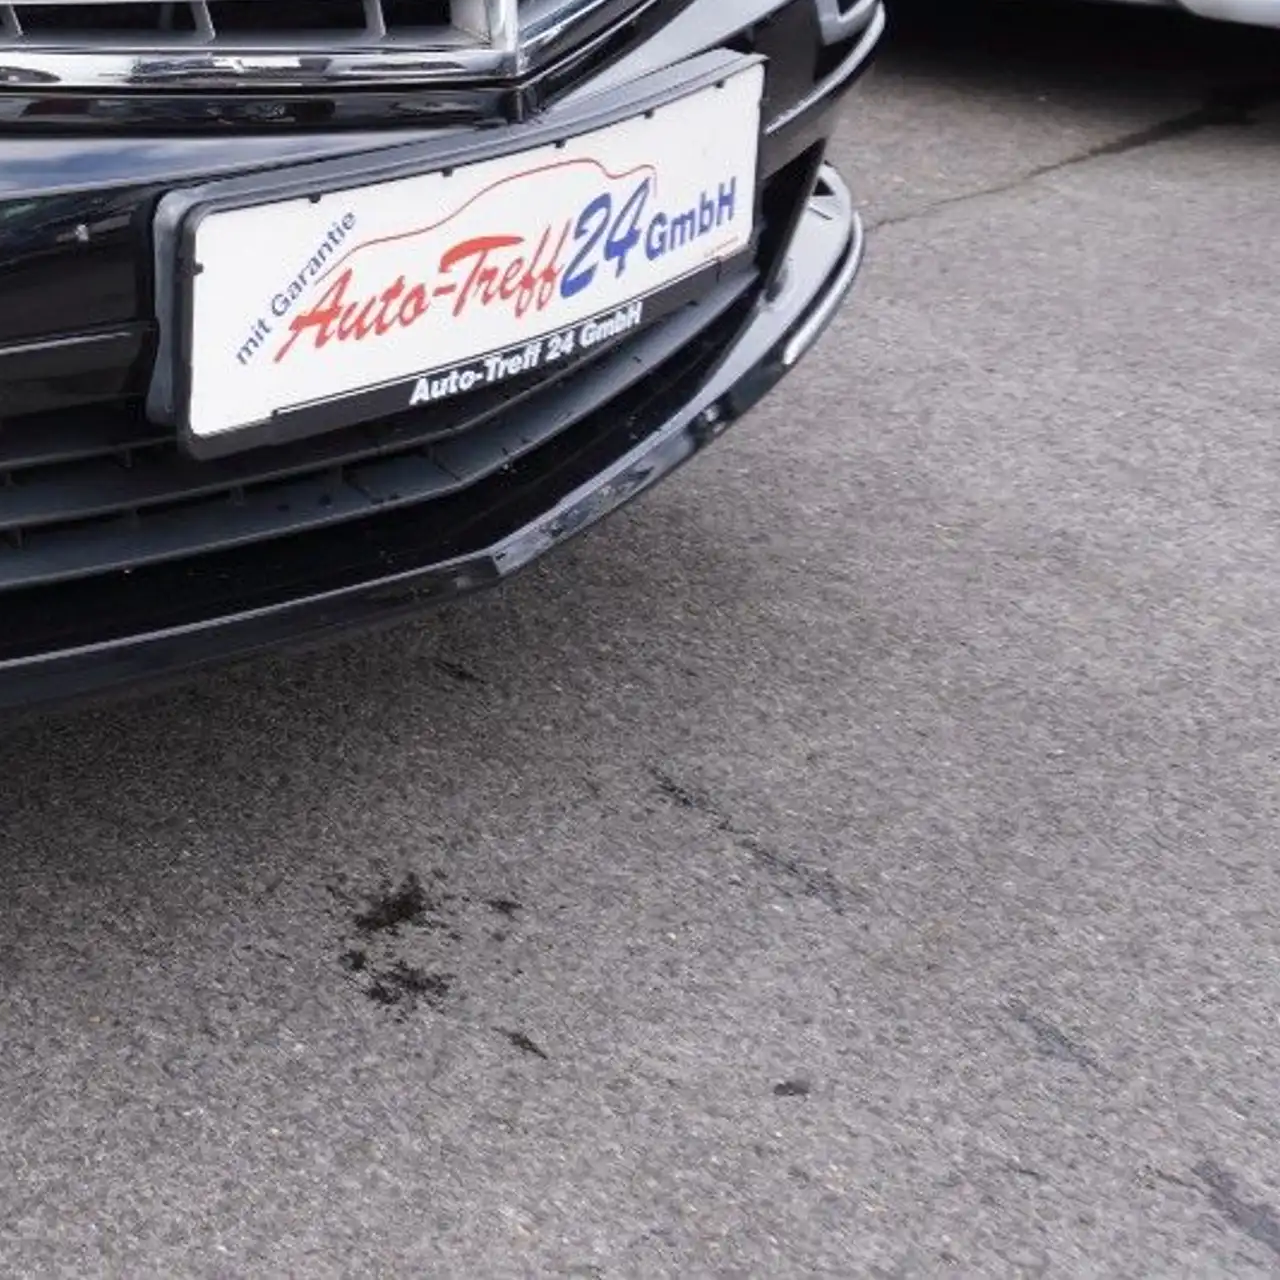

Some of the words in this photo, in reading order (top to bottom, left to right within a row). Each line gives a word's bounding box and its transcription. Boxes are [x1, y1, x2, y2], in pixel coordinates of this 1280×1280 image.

[645, 176, 737, 260] GmbH
[236, 318, 272, 365] mit
[271, 212, 357, 317] Garantie
[409, 341, 542, 406] Auto-Treff
[546, 328, 576, 362] 24
[580, 301, 644, 348] GmbH
